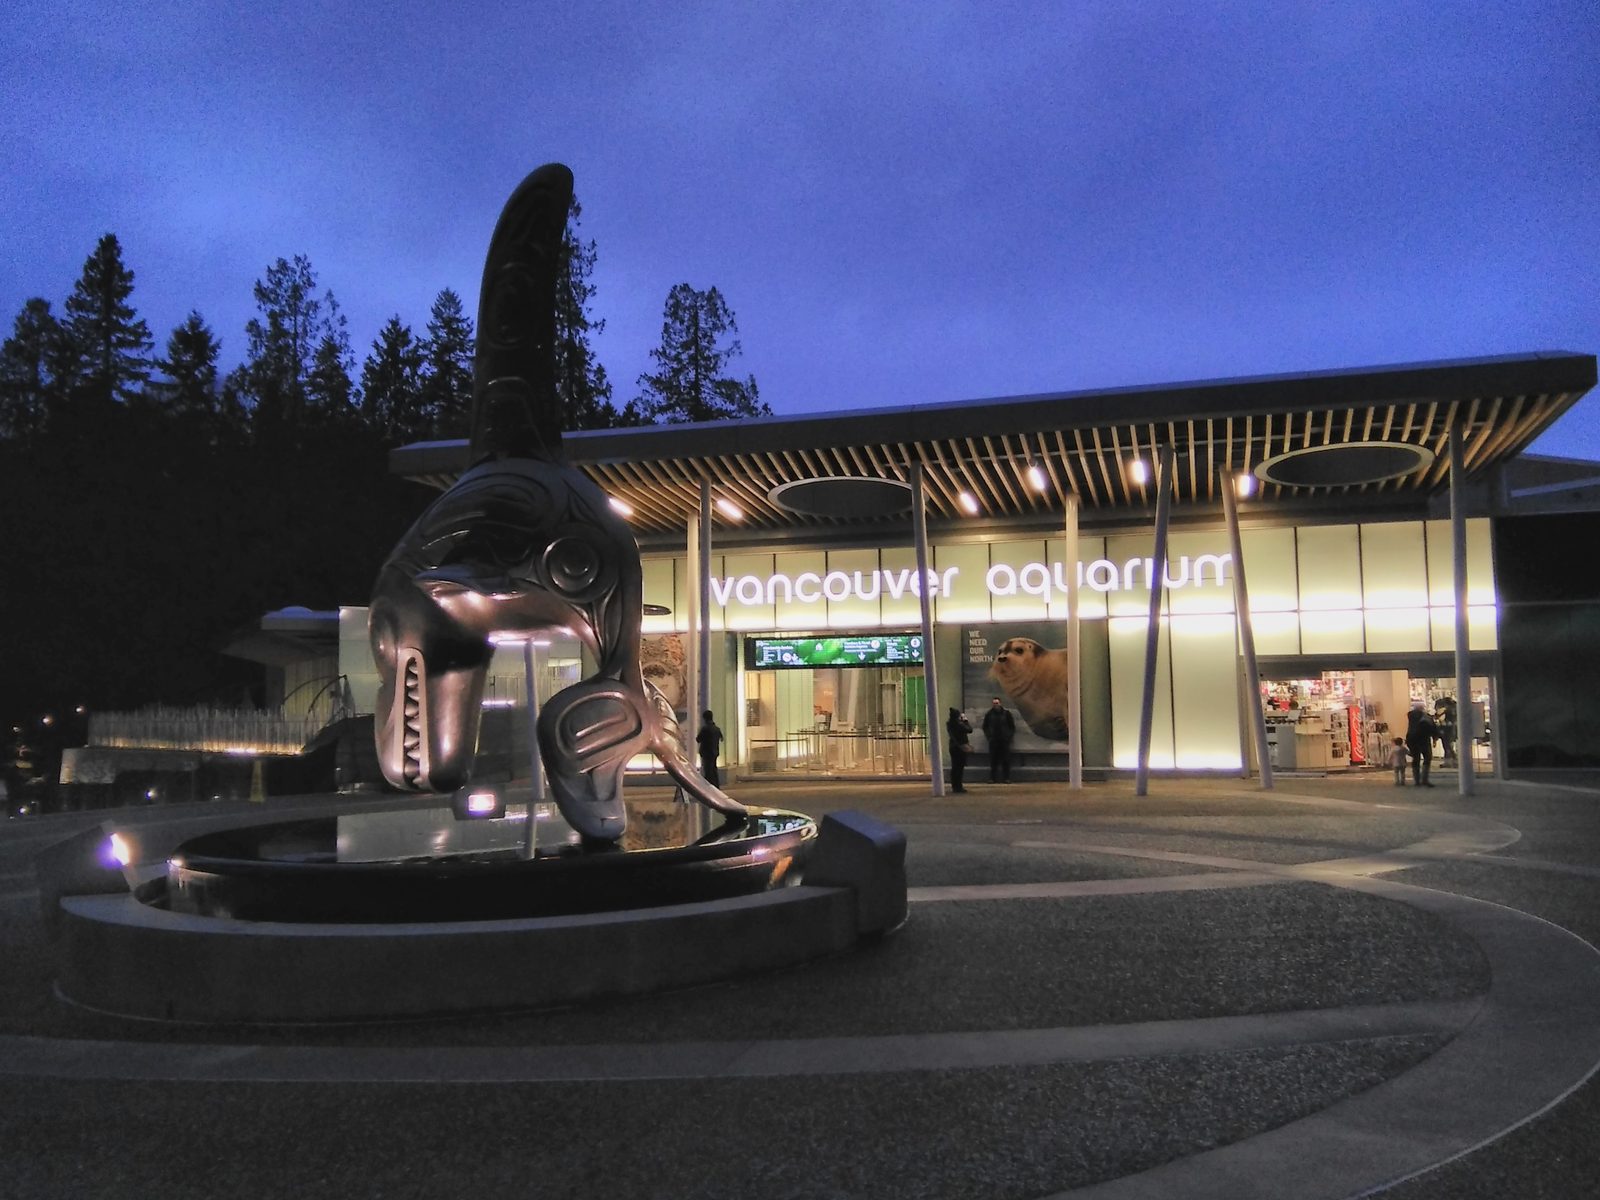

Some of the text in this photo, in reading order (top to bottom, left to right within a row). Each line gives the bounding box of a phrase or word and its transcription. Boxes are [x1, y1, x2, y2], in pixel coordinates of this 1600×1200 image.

[709, 553, 1232, 606] vancouver aquarium
[968, 630, 980, 638] WE
[969, 638, 987, 646] NEED
[969, 647, 984, 655] OUR
[969, 655, 993, 663] NORTH
